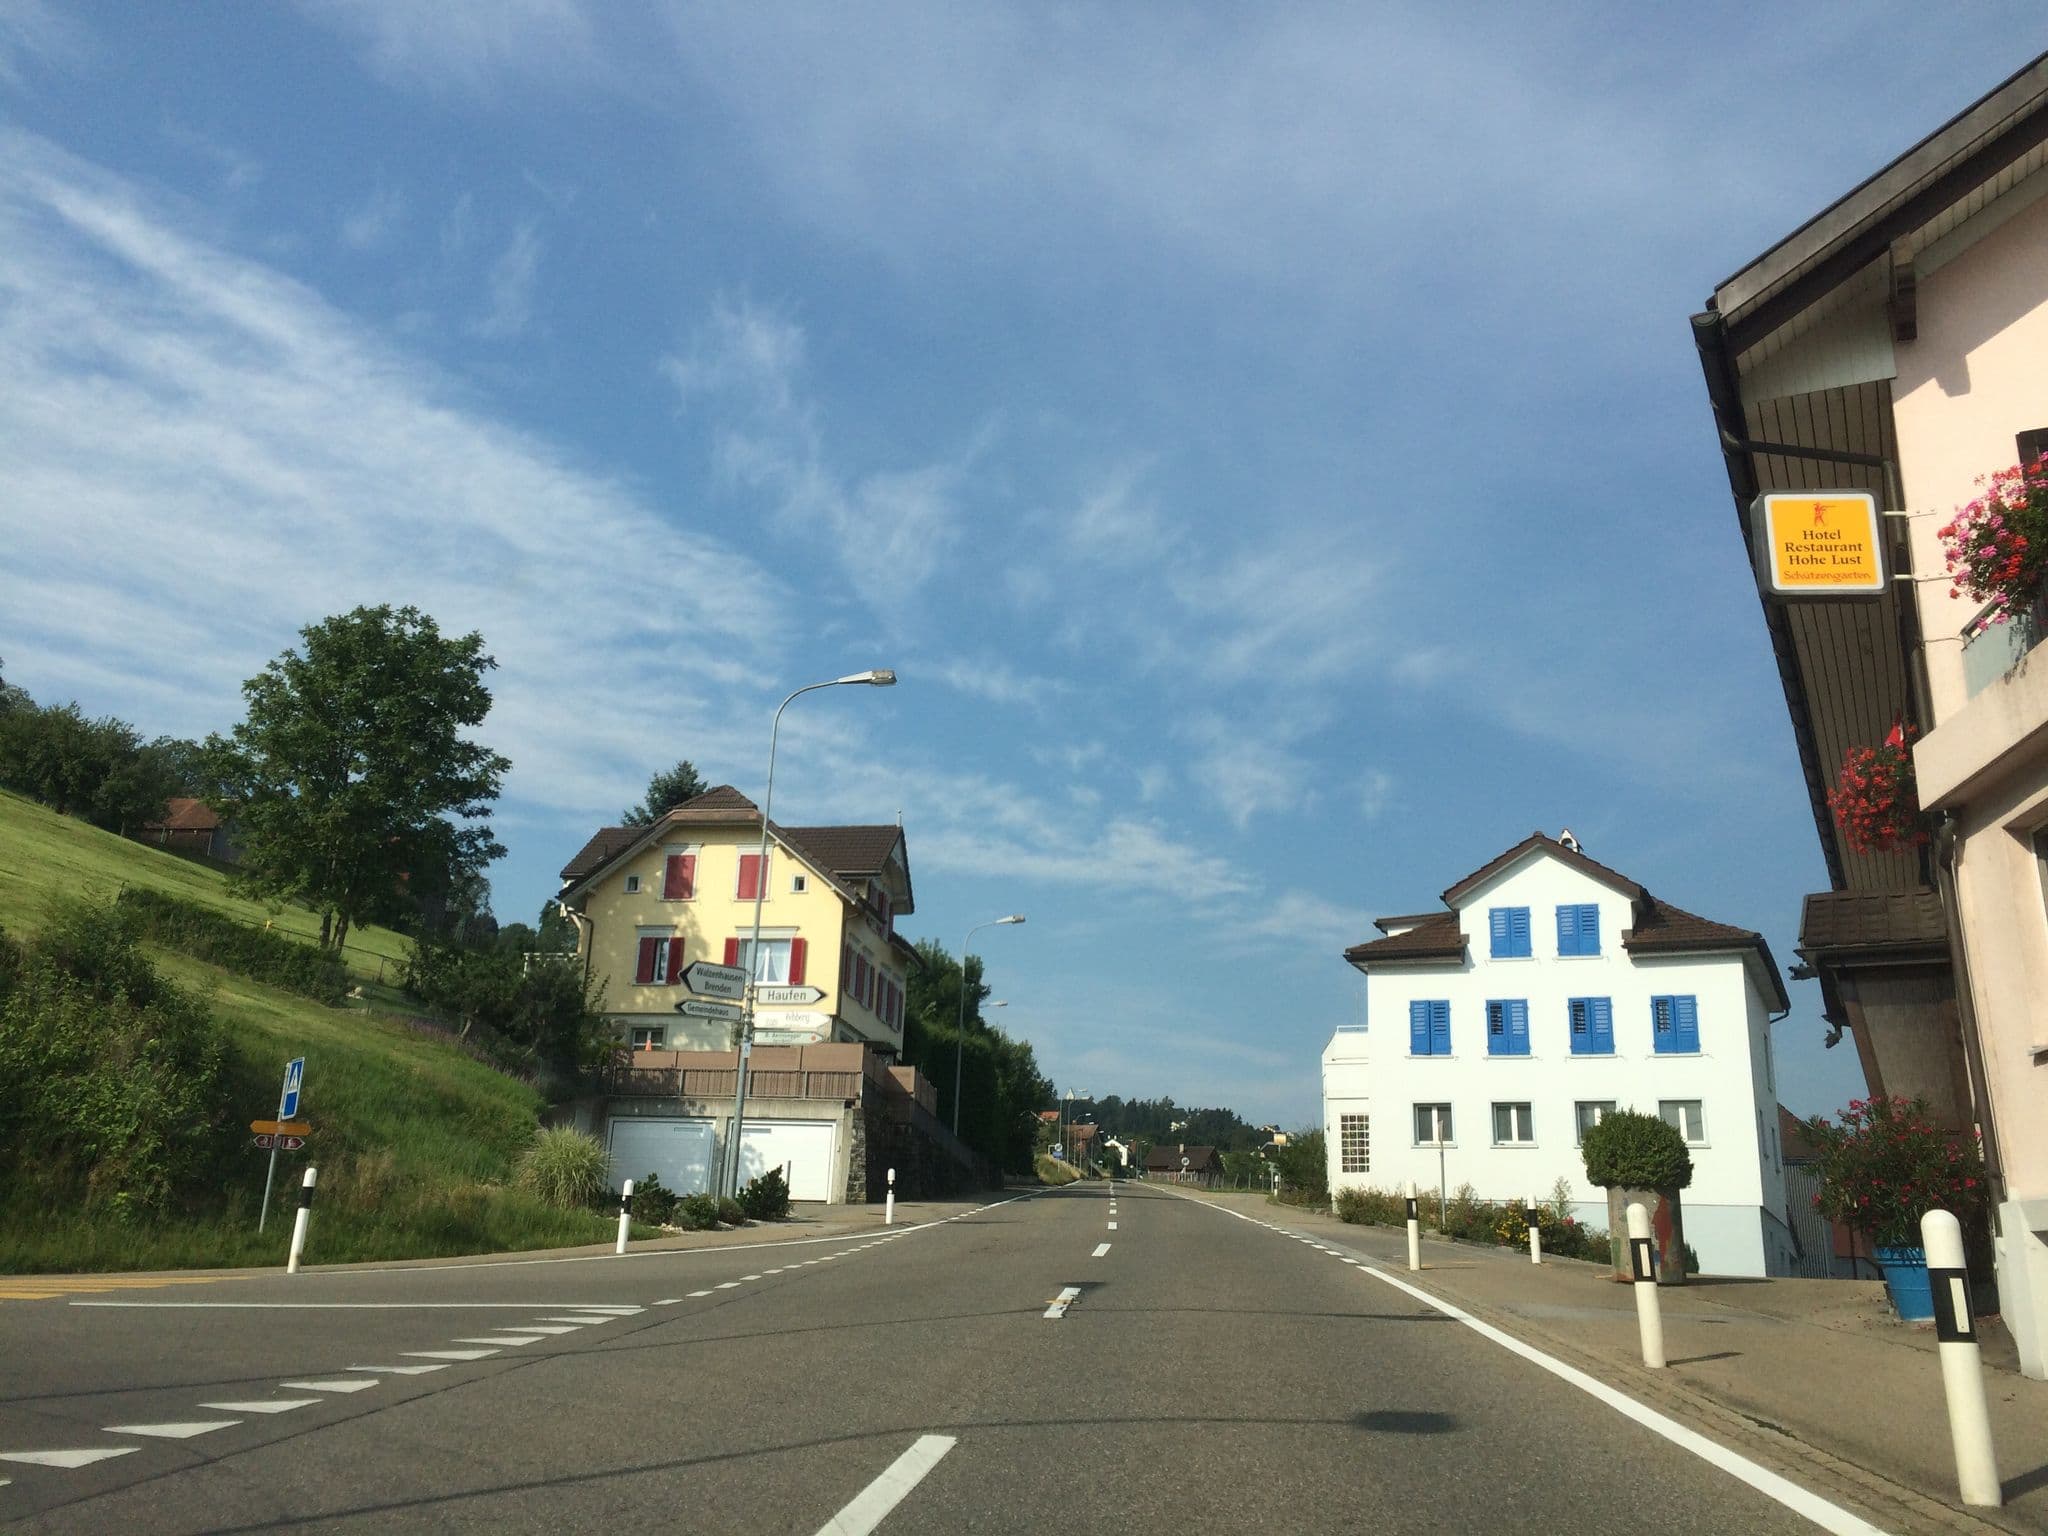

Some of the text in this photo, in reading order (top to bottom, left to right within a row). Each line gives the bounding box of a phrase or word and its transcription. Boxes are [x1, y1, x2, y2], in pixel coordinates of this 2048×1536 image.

[1803, 529, 1841, 540] Hotel
[1785, 542, 1863, 553] Restaurant
[1789, 555, 1862, 565] Hohe Lust
[696, 967, 743, 982] Walzenhausen
[704, 981, 732, 993] Brenden
[767, 990, 807, 1001] Haufen
[687, 1003, 729, 1016] Gemeindehaus
